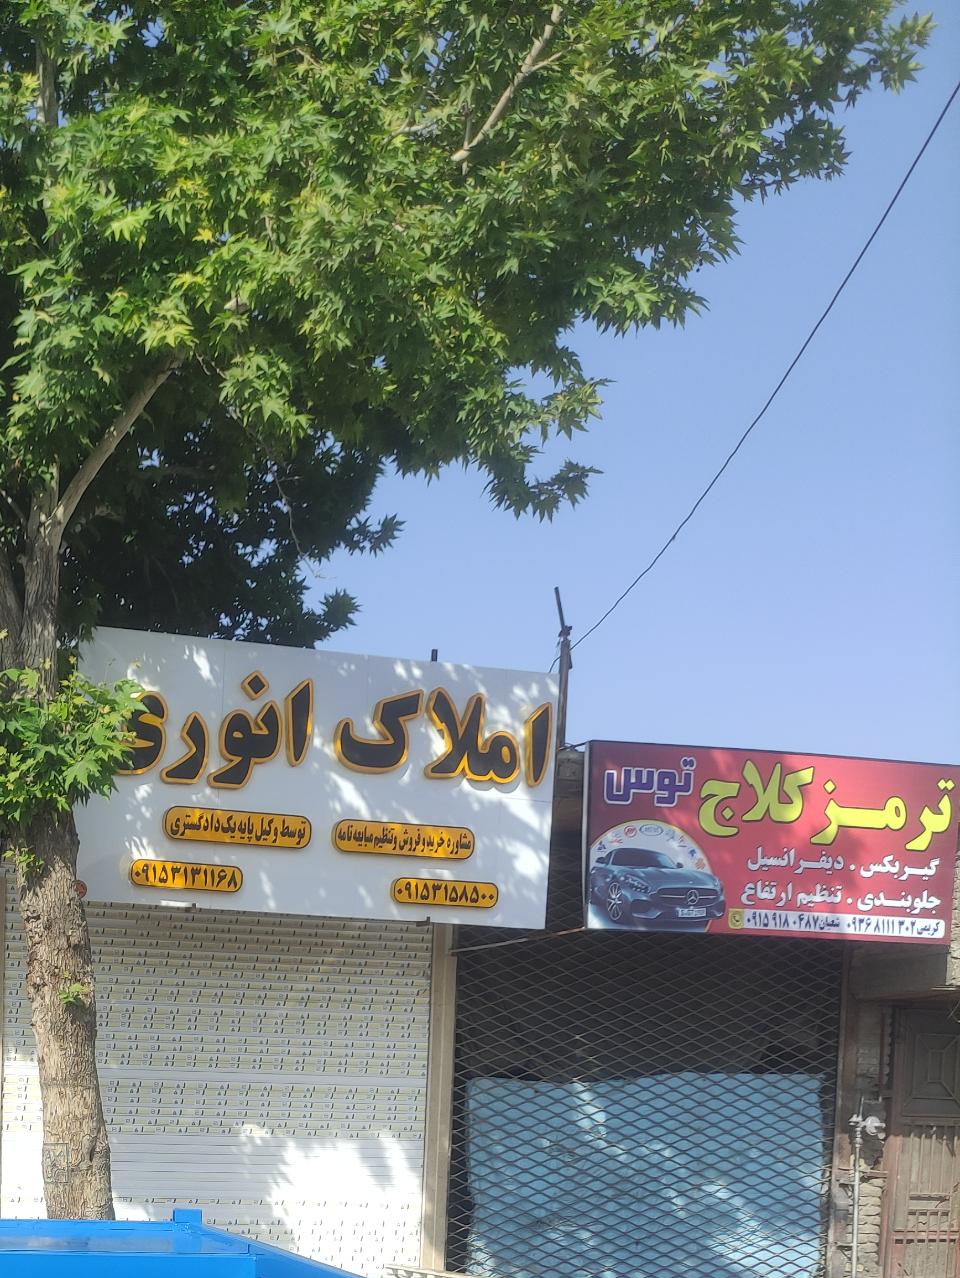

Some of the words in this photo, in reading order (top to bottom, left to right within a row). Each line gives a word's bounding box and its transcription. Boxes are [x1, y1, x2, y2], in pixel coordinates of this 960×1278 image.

[113, 670, 315, 789] انوری
[334, 686, 552, 788] املاک
[604, 756, 697, 807] توس
[696, 759, 816, 838] کلاج
[810, 777, 956, 852] ترمز
[237, 815, 254, 842] پایه
[280, 818, 307, 845] توسط
[446, 832, 472, 855] مشاوره
[747, 846, 845, 875] دیفرانسیل
[859, 854, 941, 881] گیربکس
[134, 862, 239, 888] ۰۹۱۵۳۱۳۱۱۶۸
[396, 881, 495, 904] ۰۹۱۵۳۱۵۸۵۰۰
[740, 880, 794, 907] ارتفاع
[796, 883, 843, 907] تنظیم
[856, 889, 942, 914] جلوبندی
